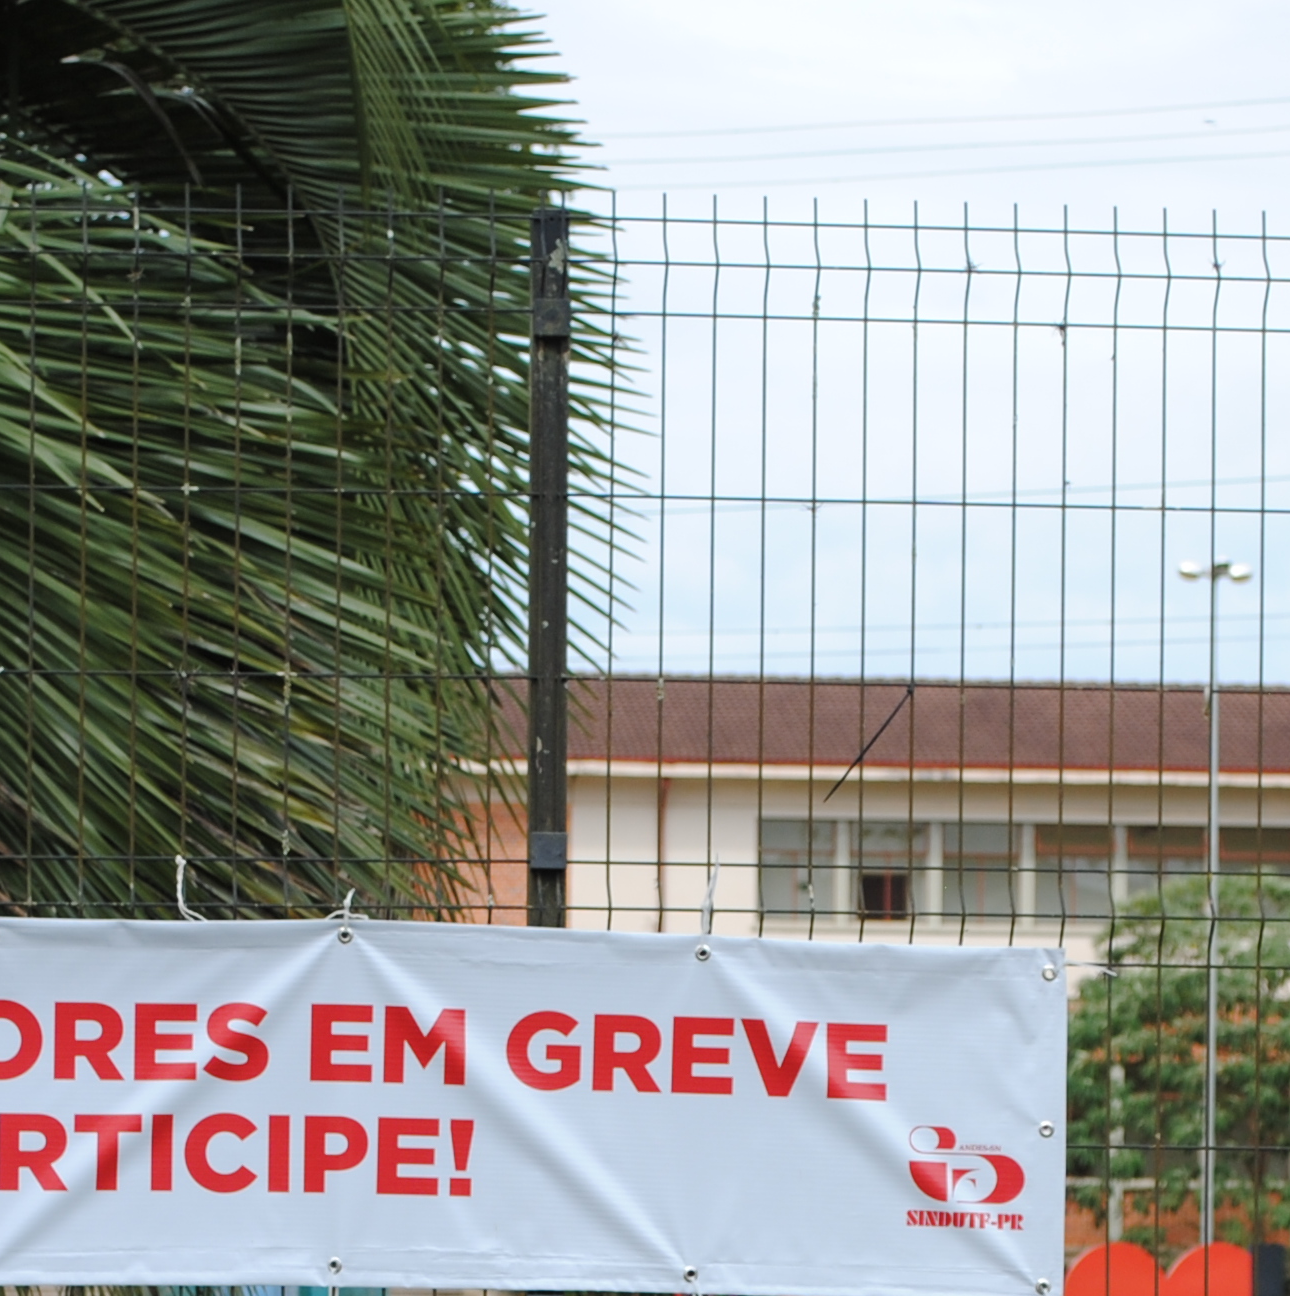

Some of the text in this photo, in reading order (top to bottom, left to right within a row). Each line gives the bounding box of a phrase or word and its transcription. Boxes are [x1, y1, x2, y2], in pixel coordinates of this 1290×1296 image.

[310, 1003, 467, 1086] EM
[506, 1010, 888, 1102] GREVE
[959, 1144, 1002, 1152] ANDES-SN
[906, 1209, 1024, 1230] SINDUTF-PR
